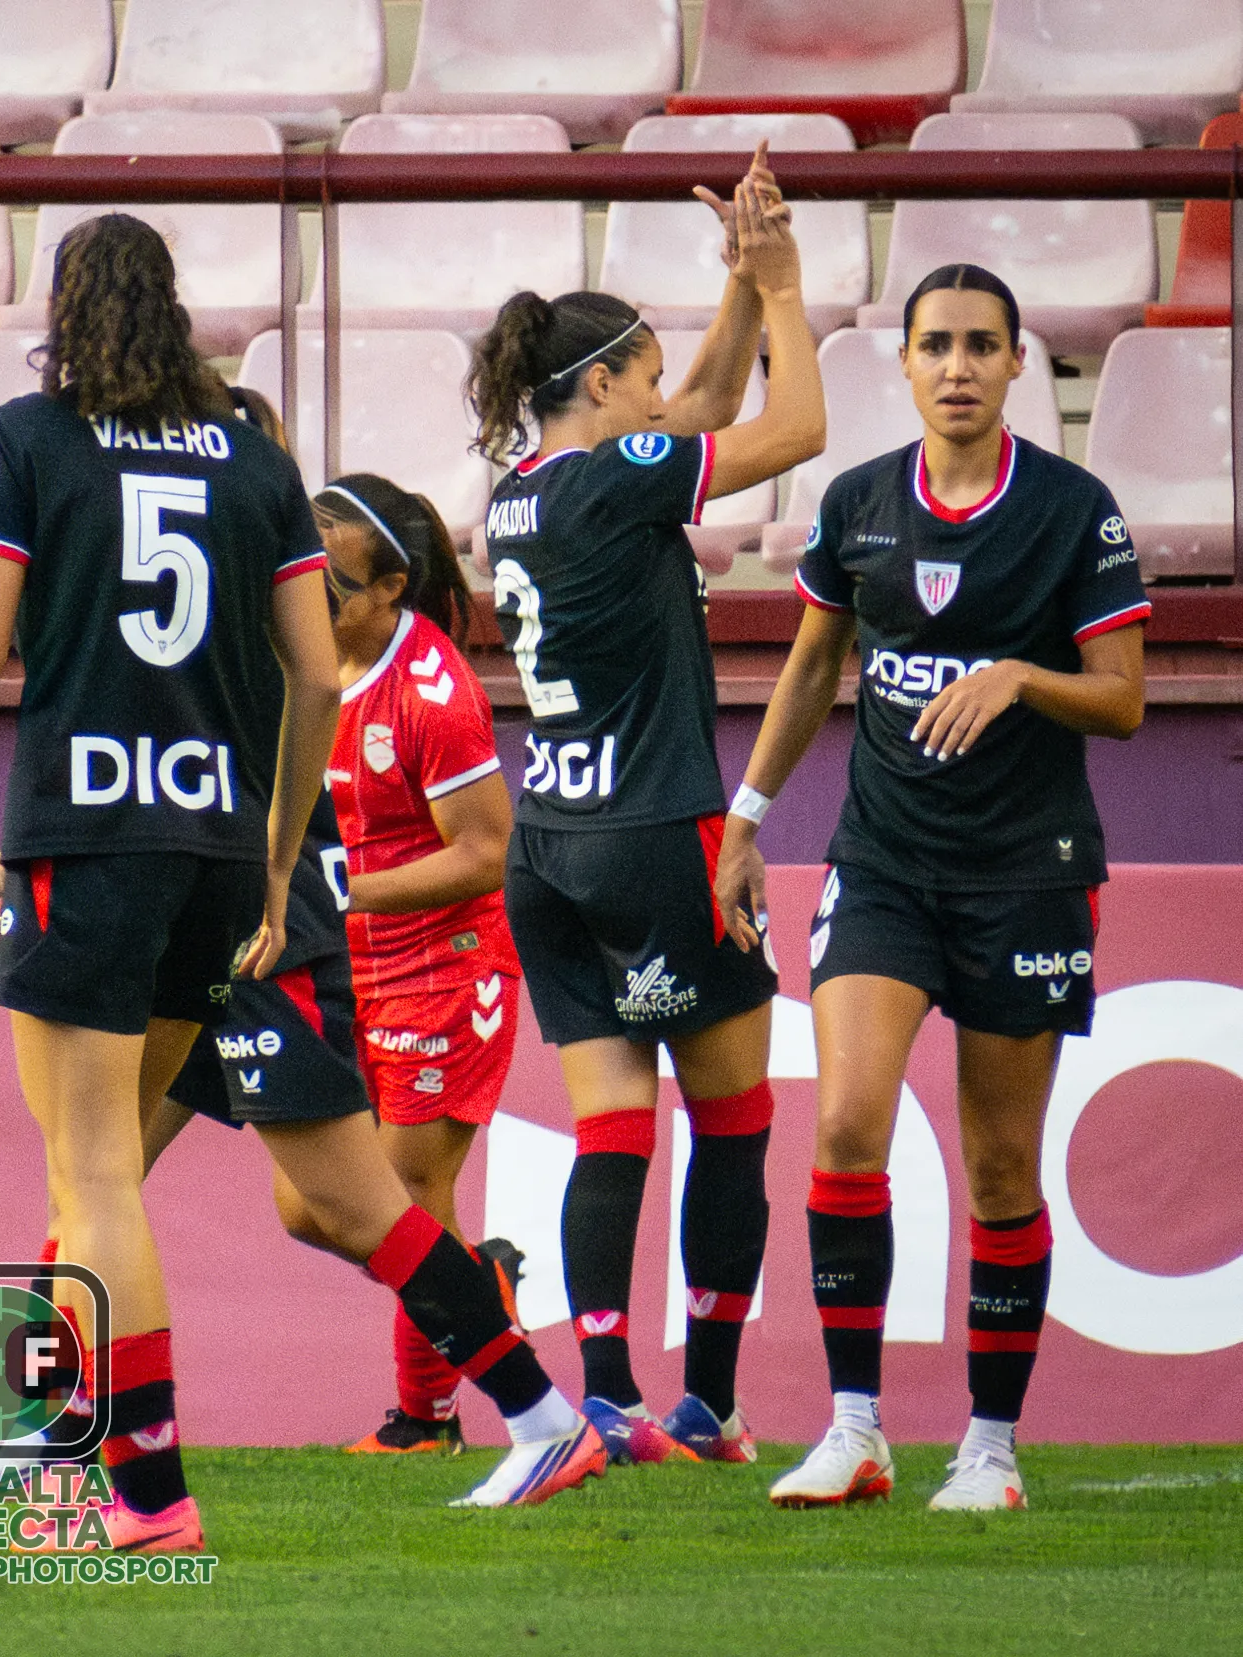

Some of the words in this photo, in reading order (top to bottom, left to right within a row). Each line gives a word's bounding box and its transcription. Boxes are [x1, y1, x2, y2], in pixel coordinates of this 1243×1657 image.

[118, 473, 210, 667] 5
[493, 558, 580, 718] 2
[71, 736, 234, 812] DIGI
[1014, 952, 1067, 976] bbk
